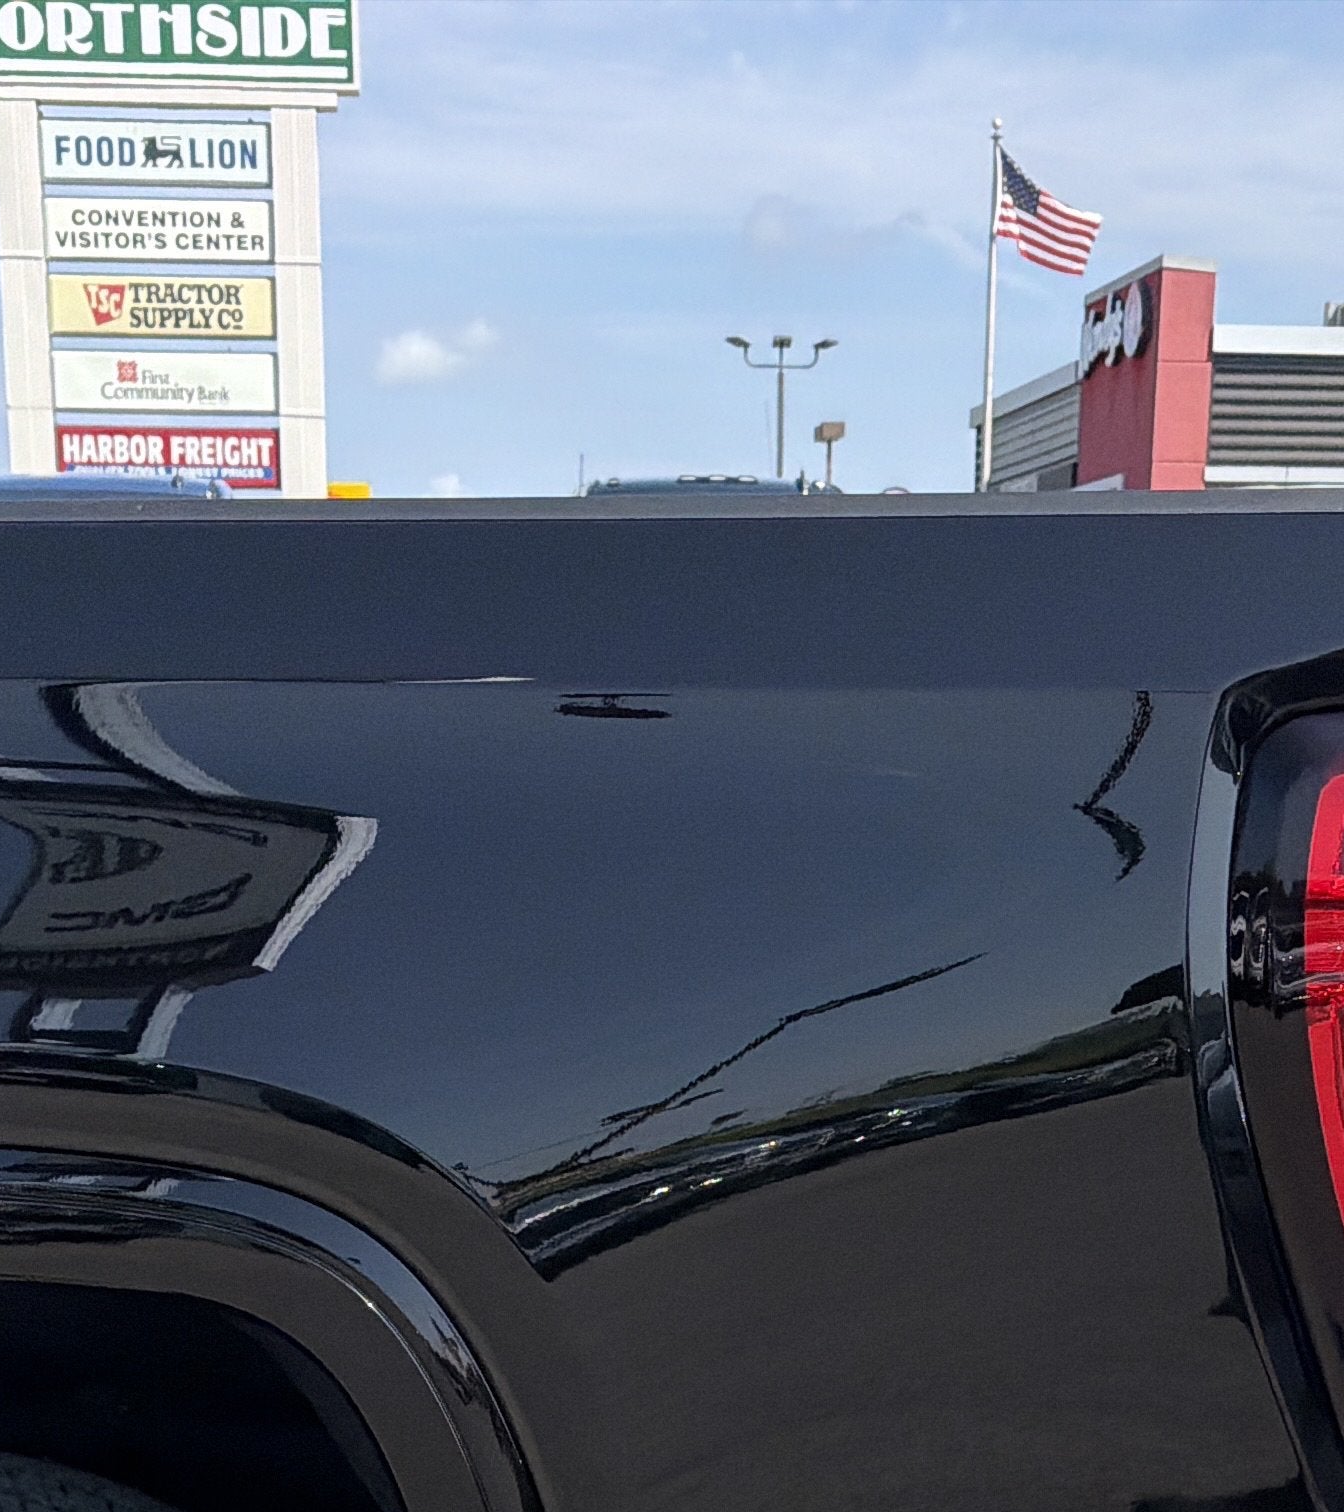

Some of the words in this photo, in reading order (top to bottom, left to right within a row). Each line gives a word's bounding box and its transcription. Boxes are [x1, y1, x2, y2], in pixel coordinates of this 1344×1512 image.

[55, 135, 136, 167] FOOD
[188, 138, 258, 170] LION
[71, 209, 221, 228] CONVENTION
[230, 211, 245, 229] &
[56, 231, 167, 250] VISITOR'S
[175, 233, 265, 252] CENTER
[86, 283, 122, 320] TSC
[128, 282, 242, 306] TRACTOR
[129, 306, 214, 328] SUPPLY
[141, 369, 170, 385] First
[100, 380, 195, 404] Community
[197, 385, 231, 401] Bank
[62, 433, 165, 464] HARBOR
[170, 435, 274, 466] FREIGHT
